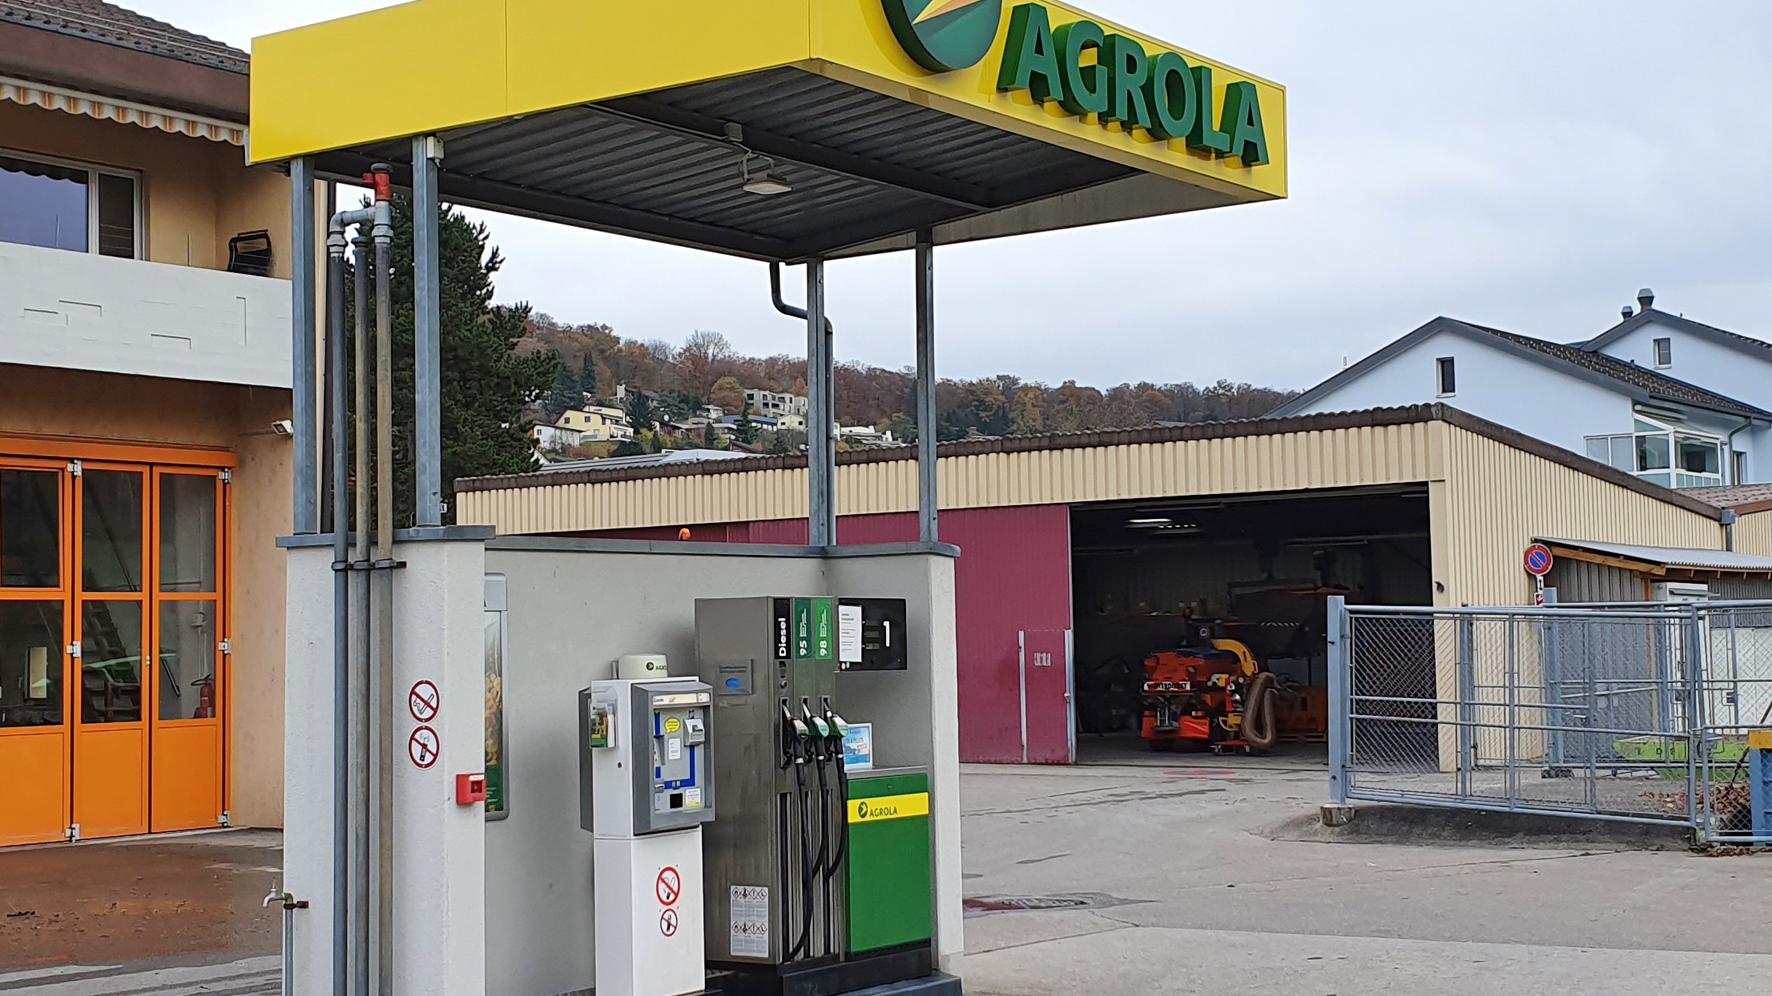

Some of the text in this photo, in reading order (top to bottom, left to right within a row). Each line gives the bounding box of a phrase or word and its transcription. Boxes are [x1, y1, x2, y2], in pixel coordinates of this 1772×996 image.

[998, 2, 1270, 167] AGROLA
[778, 617, 787, 657] Diesel
[882, 620, 892, 648] 1
[799, 640, 808, 656] 95
[819, 640, 828, 657] 98
[868, 806, 898, 818] AGROLA
